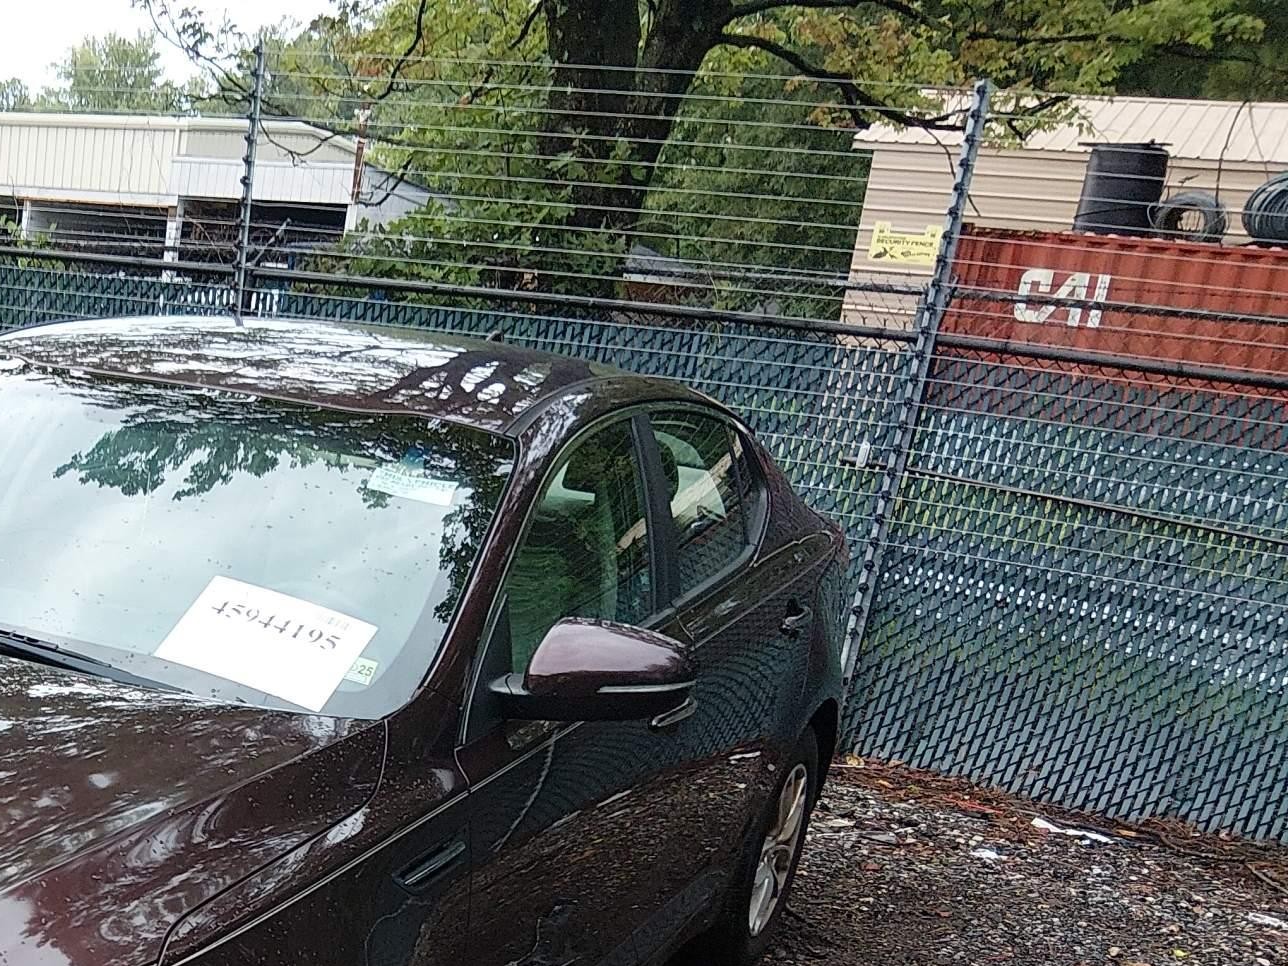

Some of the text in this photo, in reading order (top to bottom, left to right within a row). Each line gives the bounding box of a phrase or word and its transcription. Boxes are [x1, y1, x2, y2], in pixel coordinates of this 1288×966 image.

[876, 238, 910, 246] SECURITY
[211, 600, 342, 650] 45944195
[357, 663, 374, 678] 25
